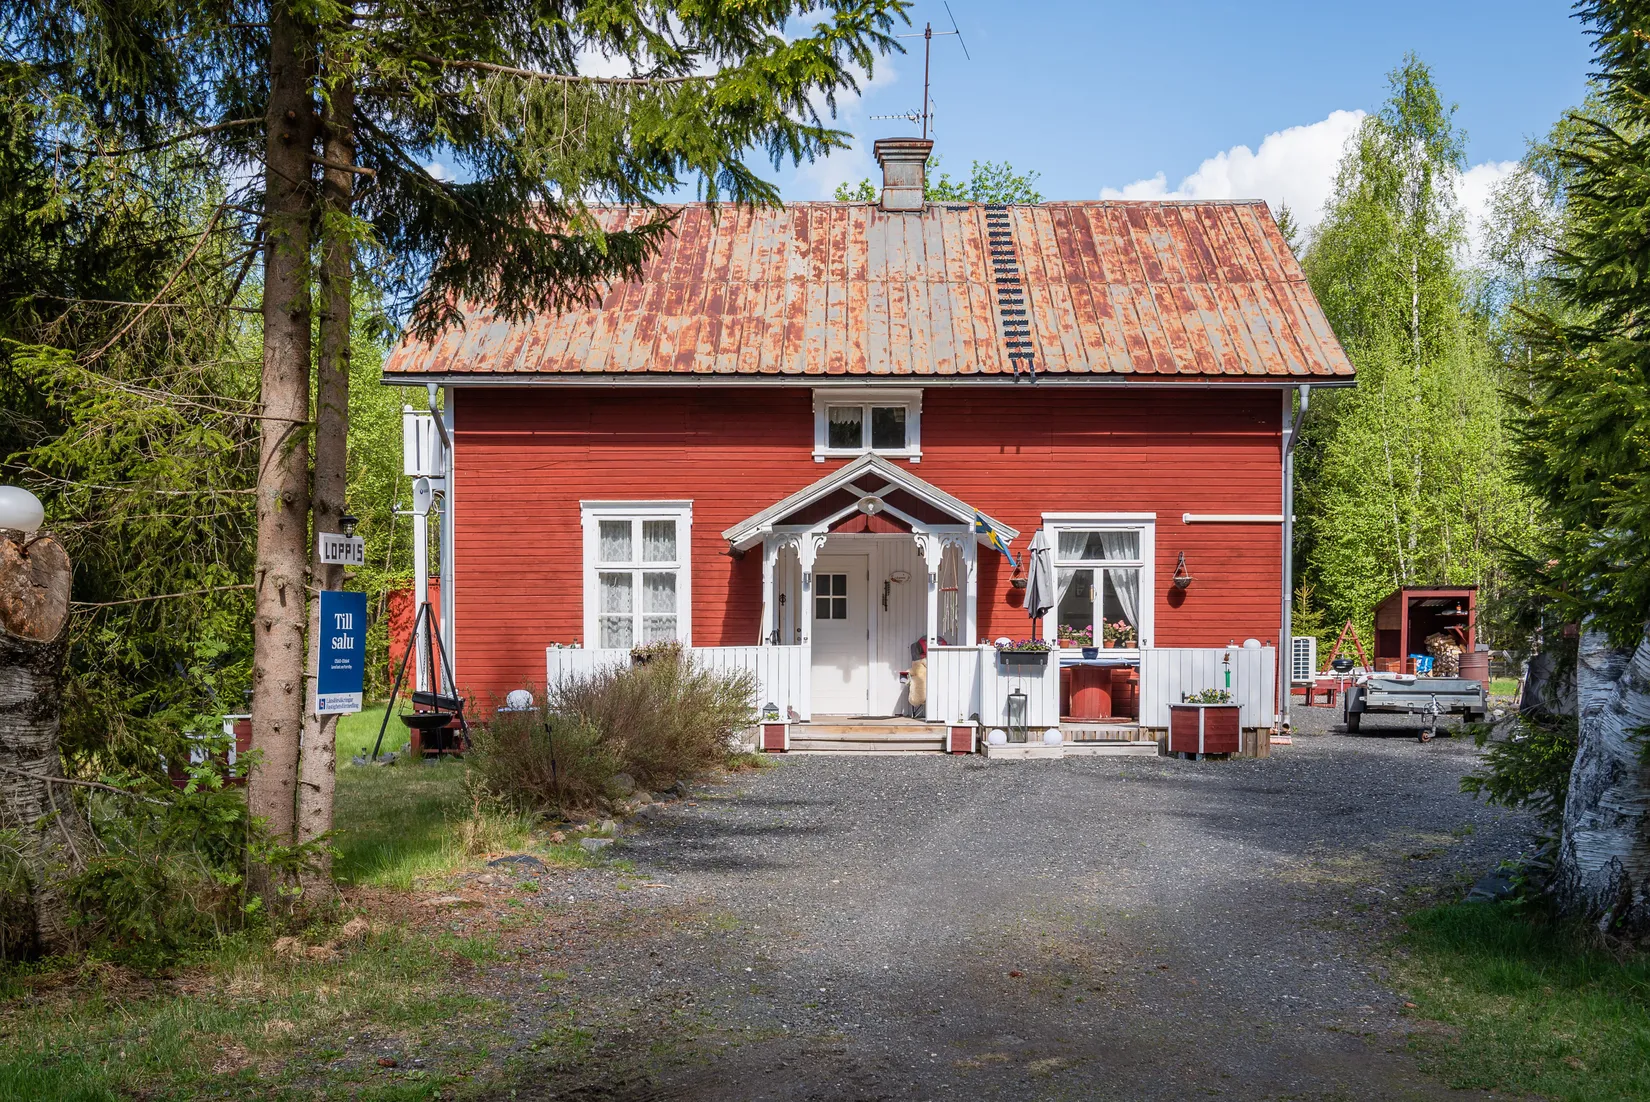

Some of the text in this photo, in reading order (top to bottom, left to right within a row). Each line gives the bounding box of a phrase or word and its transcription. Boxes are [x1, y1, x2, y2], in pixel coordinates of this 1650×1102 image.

[325, 541, 363, 562] LOPPIS
[334, 613, 353, 630] Till
[331, 632, 354, 650] salu
